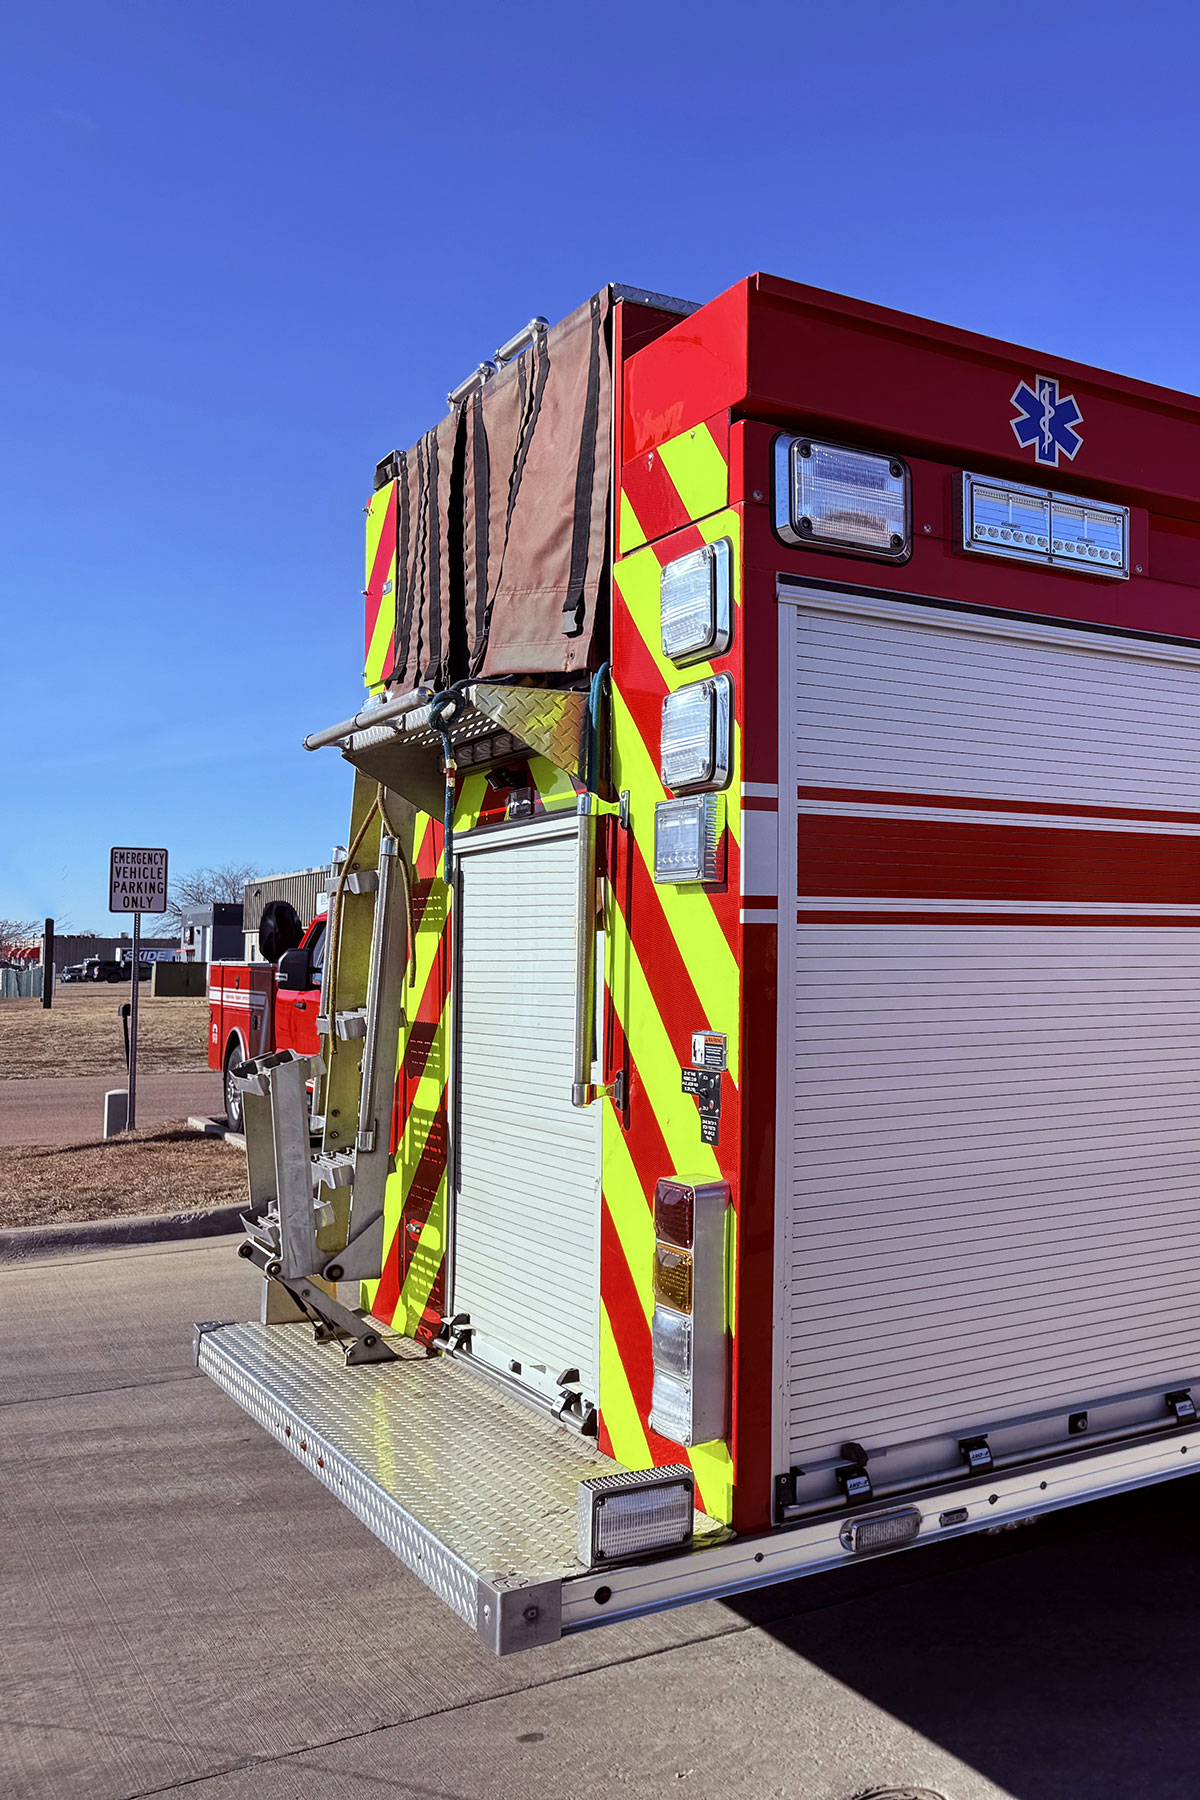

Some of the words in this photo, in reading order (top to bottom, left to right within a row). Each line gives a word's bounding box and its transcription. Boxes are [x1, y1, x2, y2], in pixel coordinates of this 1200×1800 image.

[114, 852, 164, 865] EMERGENCY
[115, 866, 163, 880] VEHICLE
[114, 881, 164, 894] PARKING
[122, 896, 154, 908] ONLY
